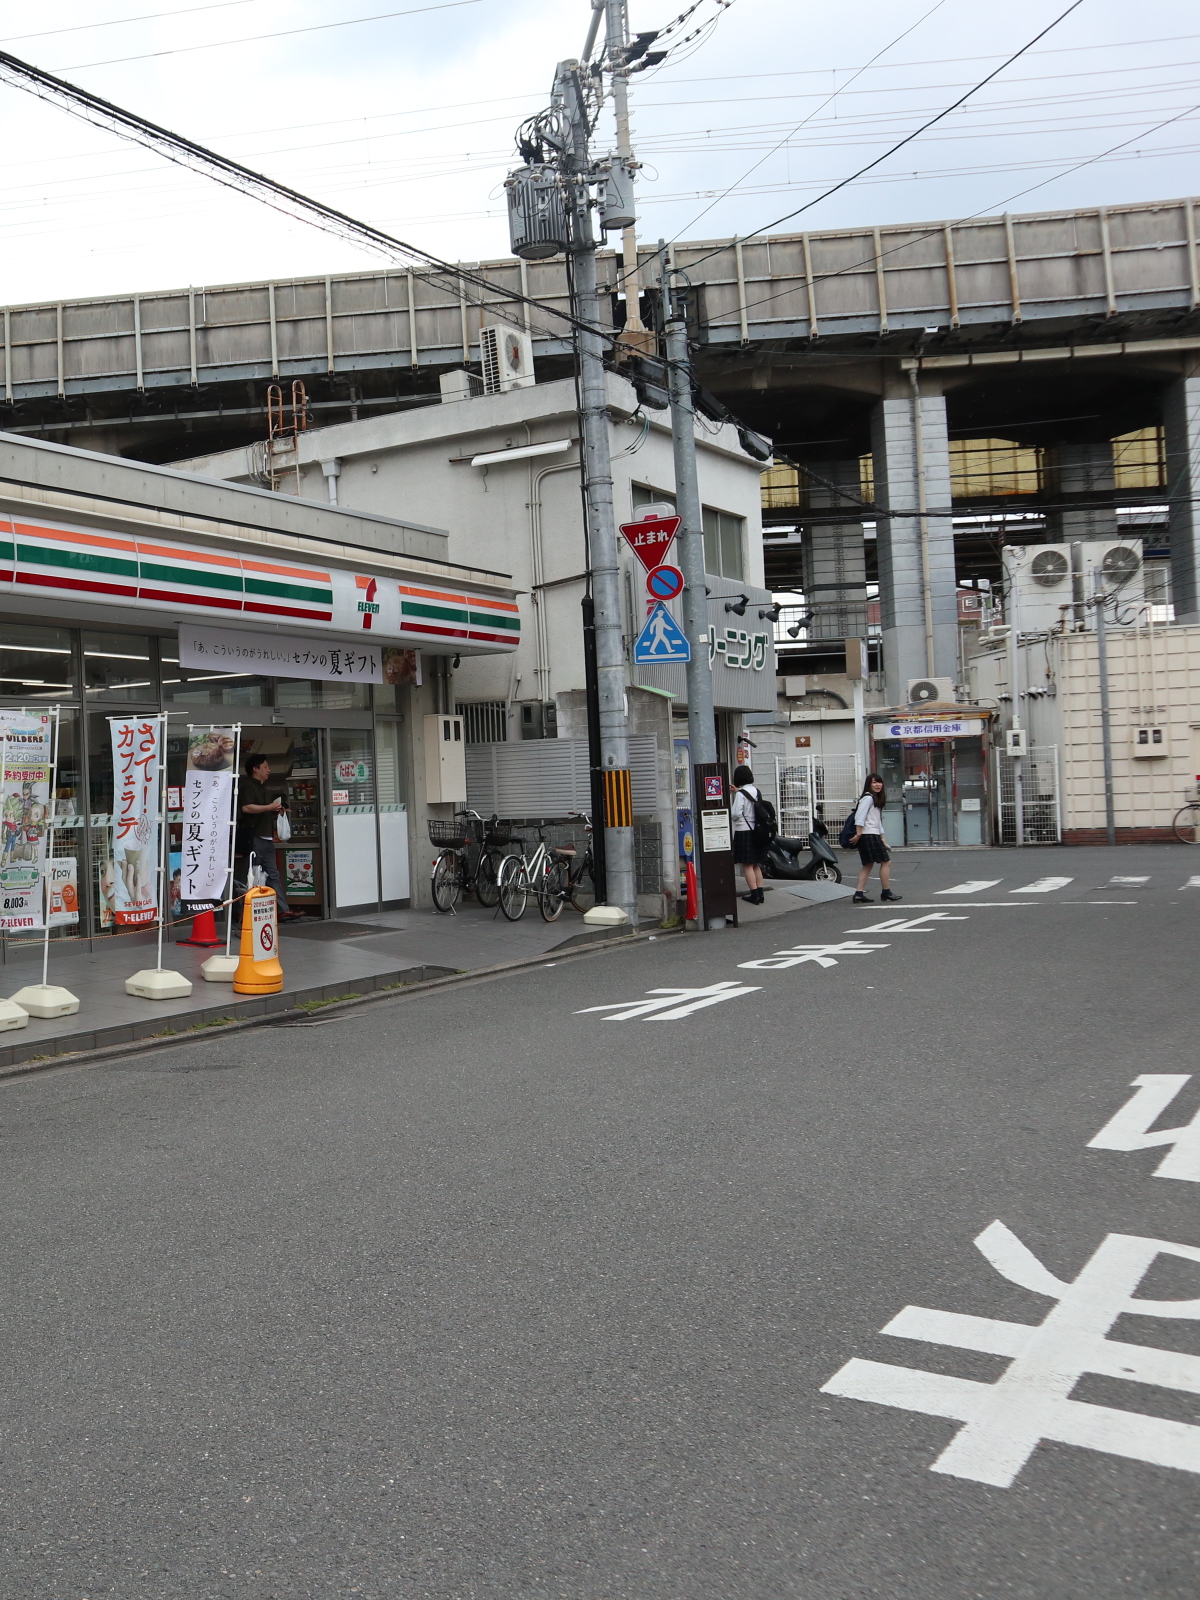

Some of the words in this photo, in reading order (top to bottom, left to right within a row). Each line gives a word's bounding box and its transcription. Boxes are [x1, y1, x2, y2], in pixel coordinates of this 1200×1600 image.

[633, 529, 669, 547] 止まれ
[355, 575, 377, 630] 7
[357, 601, 379, 614] ELEVEN
[903, 723, 961, 735] 京都信用金庫
[0, 735, 43, 743] UILDERS
[134, 722, 156, 814] さて!
[4, 770, 46, 781] 予約受付中!
[117, 724, 139, 840] カフェラテ
[186, 779, 205, 895] セブンの夏ギフト
[51, 868, 71, 881] 7pay
[3, 897, 29, 909] 8,003円
[0, 917, 34, 927] 7-ELEVEN
[571, 912, 970, 1021] 止まれ
